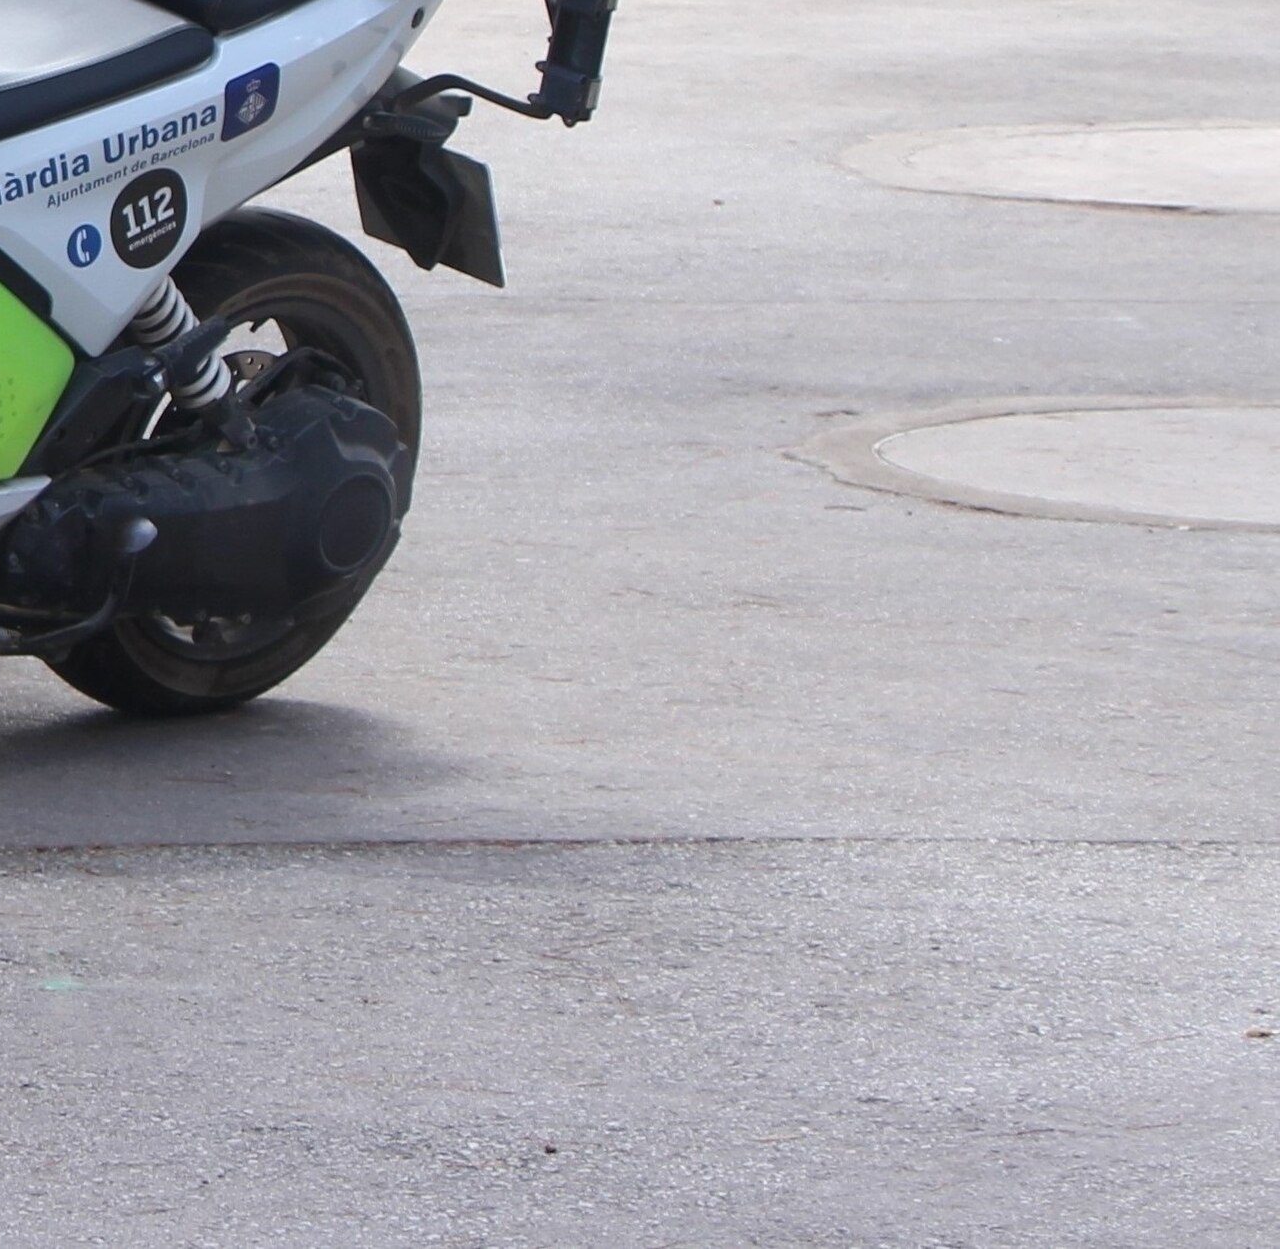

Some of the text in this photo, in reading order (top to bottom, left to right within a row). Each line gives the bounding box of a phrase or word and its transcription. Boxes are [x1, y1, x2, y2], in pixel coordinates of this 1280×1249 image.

[102, 104, 217, 164] Urbana
[47, 132, 216, 209] Ajuntament de Barcelona
[122, 186, 175, 239] 112
